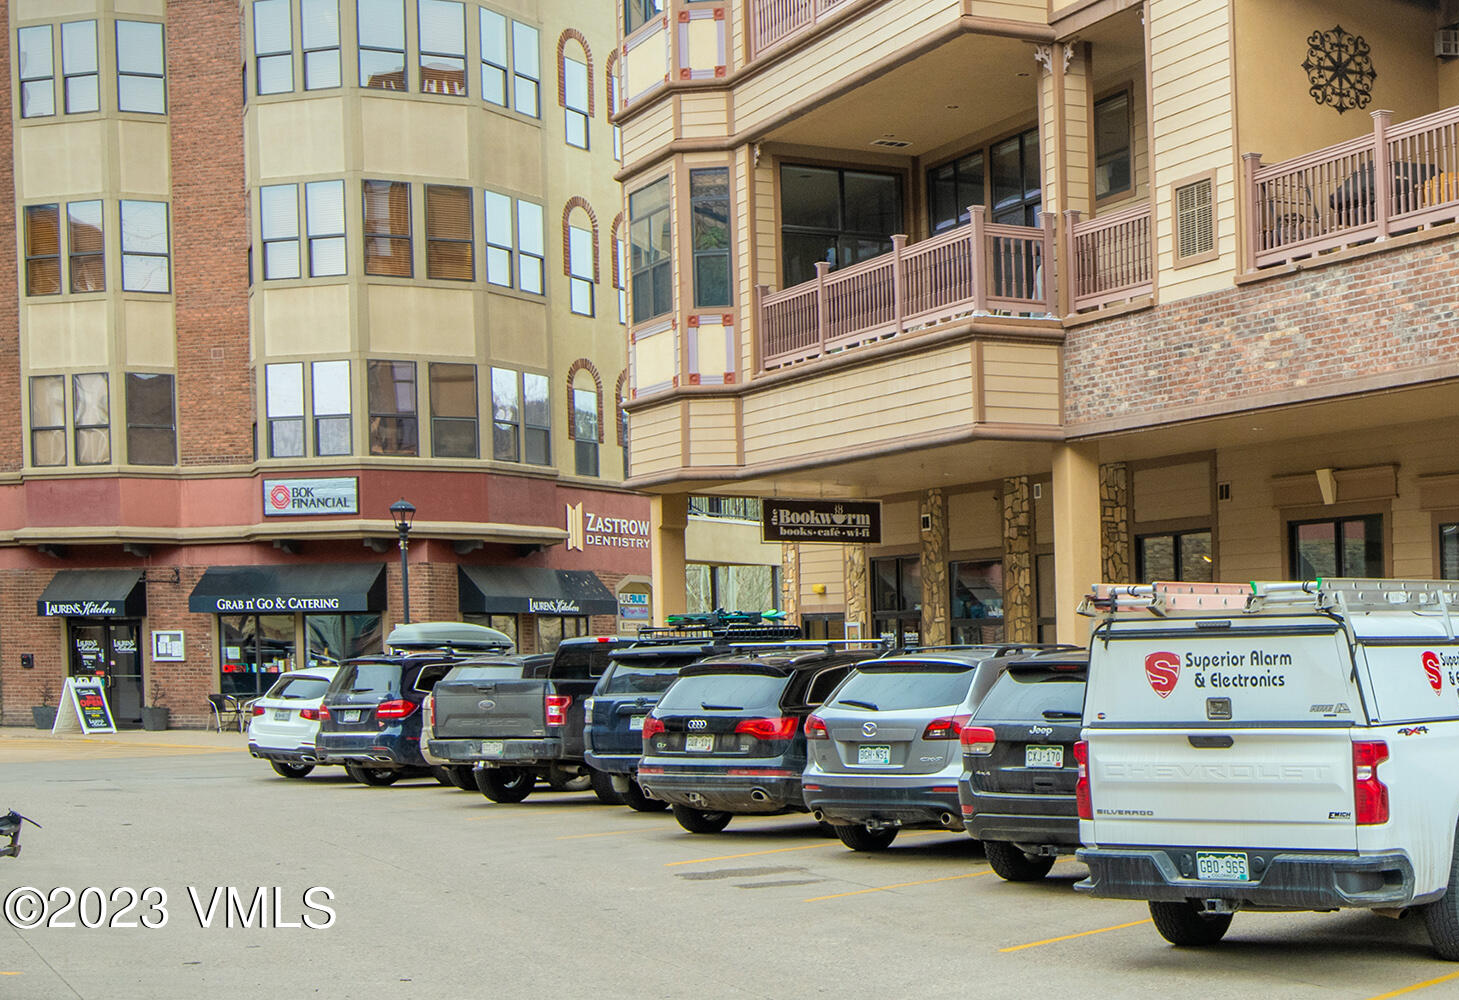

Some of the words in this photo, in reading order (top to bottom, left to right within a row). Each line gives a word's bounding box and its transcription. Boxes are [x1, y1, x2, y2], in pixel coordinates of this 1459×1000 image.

[292, 487, 314, 498] BOK
[292, 497, 349, 509] FINANCIAL
[779, 508, 871, 525] Bookworm
[585, 512, 650, 536] ZASTROW
[586, 535, 650, 549] DENTISTRY
[79, 601, 117, 616] Kitchen
[216, 599, 244, 610] GRAB
[256, 598, 274, 609] GO
[275, 597, 286, 609] &
[288, 597, 339, 609] CATERING
[553, 599, 580, 613] Kitchen
[1186, 651, 1246, 671] Superior
[1250, 650, 1292, 666] Alarm
[1194, 674, 1206, 688] &
[1210, 669, 1285, 688] Electronics
[1029, 725, 1053, 736] Jeep
[1104, 763, 1331, 780] CHEVROLET
[1096, 808, 1154, 816] SILVERADO
